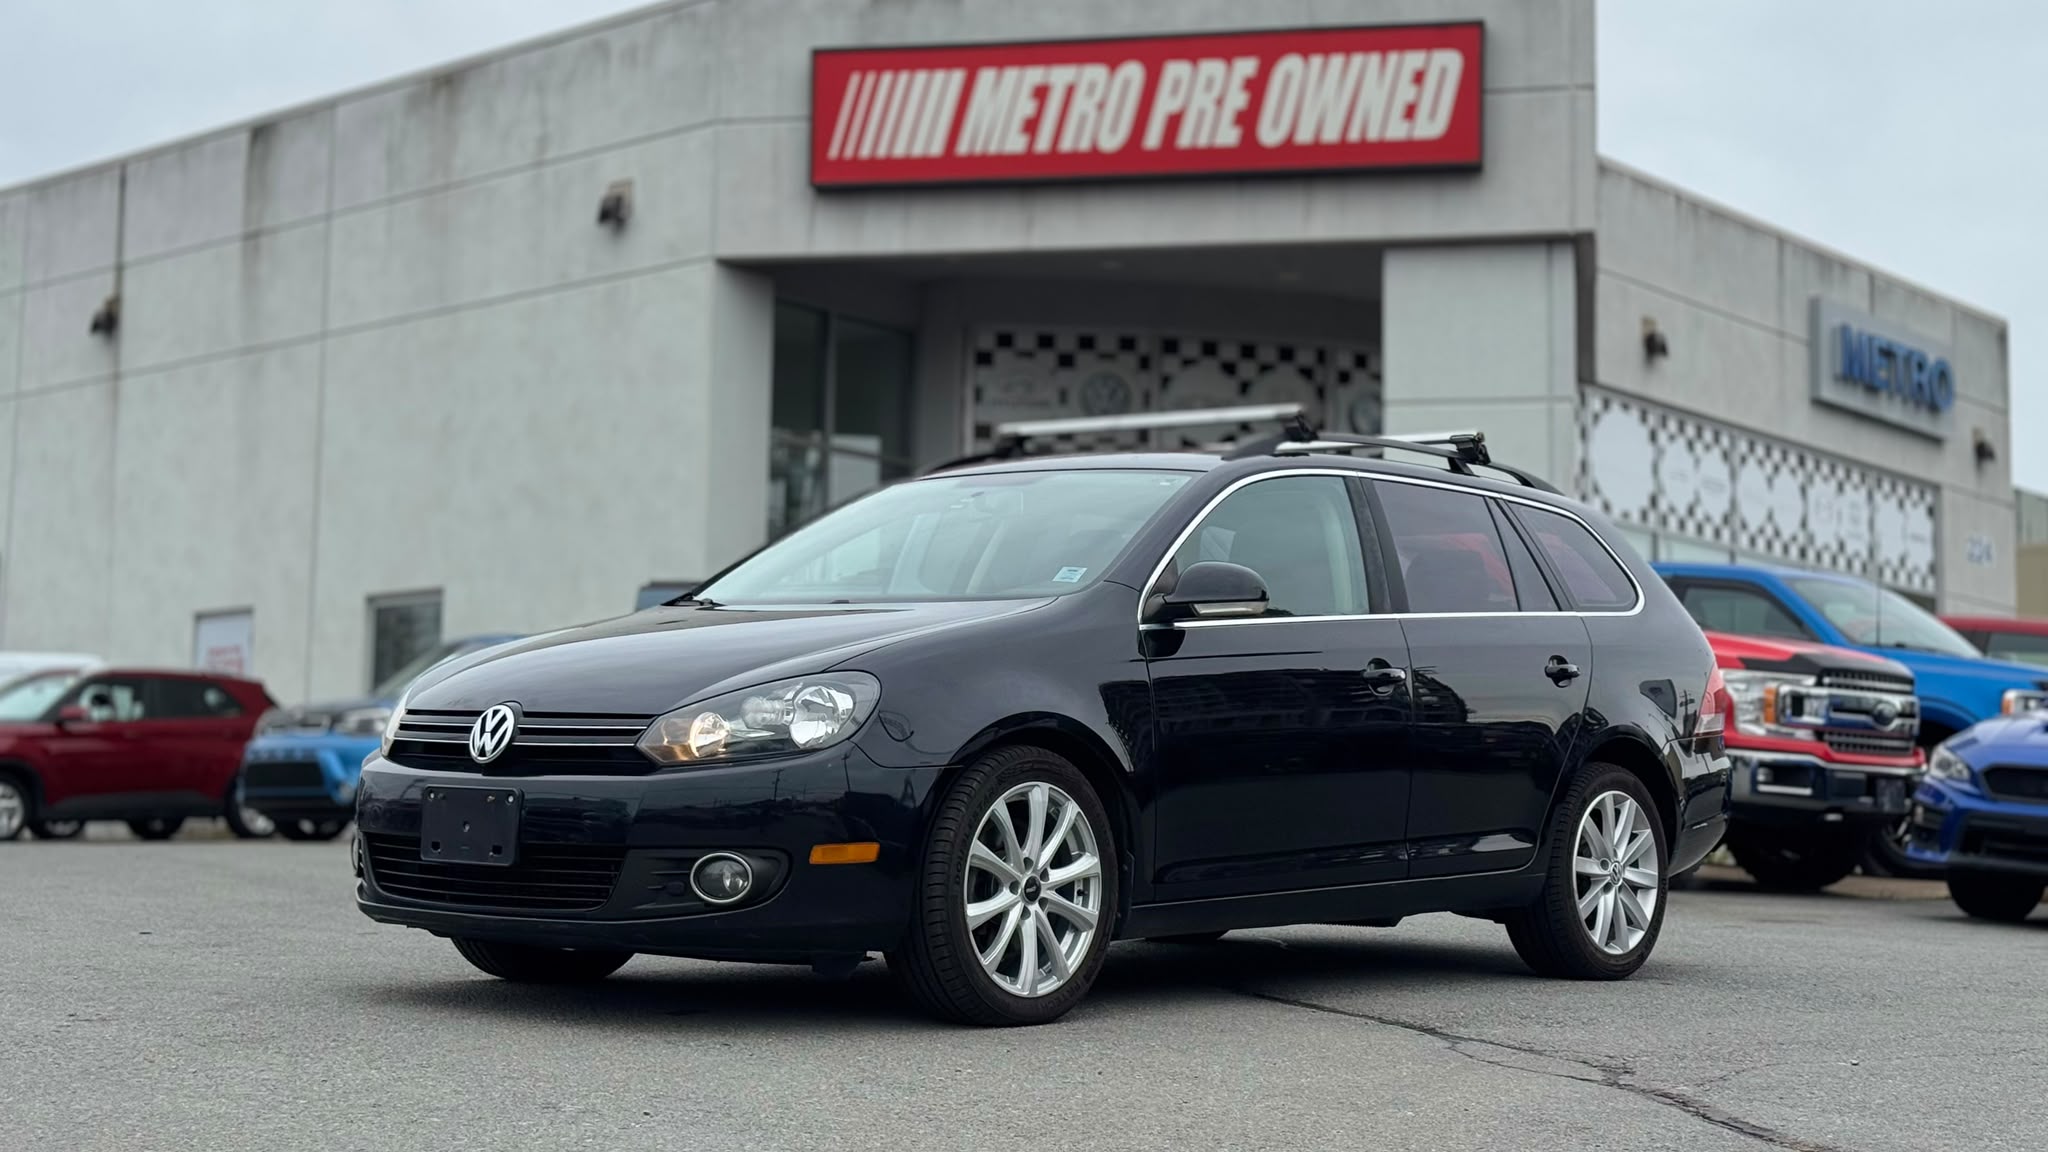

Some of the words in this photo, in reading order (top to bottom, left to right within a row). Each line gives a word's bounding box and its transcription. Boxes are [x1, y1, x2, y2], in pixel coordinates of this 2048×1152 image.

[954, 61, 1146, 156] METRO
[1142, 57, 1259, 151] PRE
[1255, 49, 1464, 148] OWNED
[1836, 323, 1955, 411] METRO
[469, 704, 514, 762] VW
